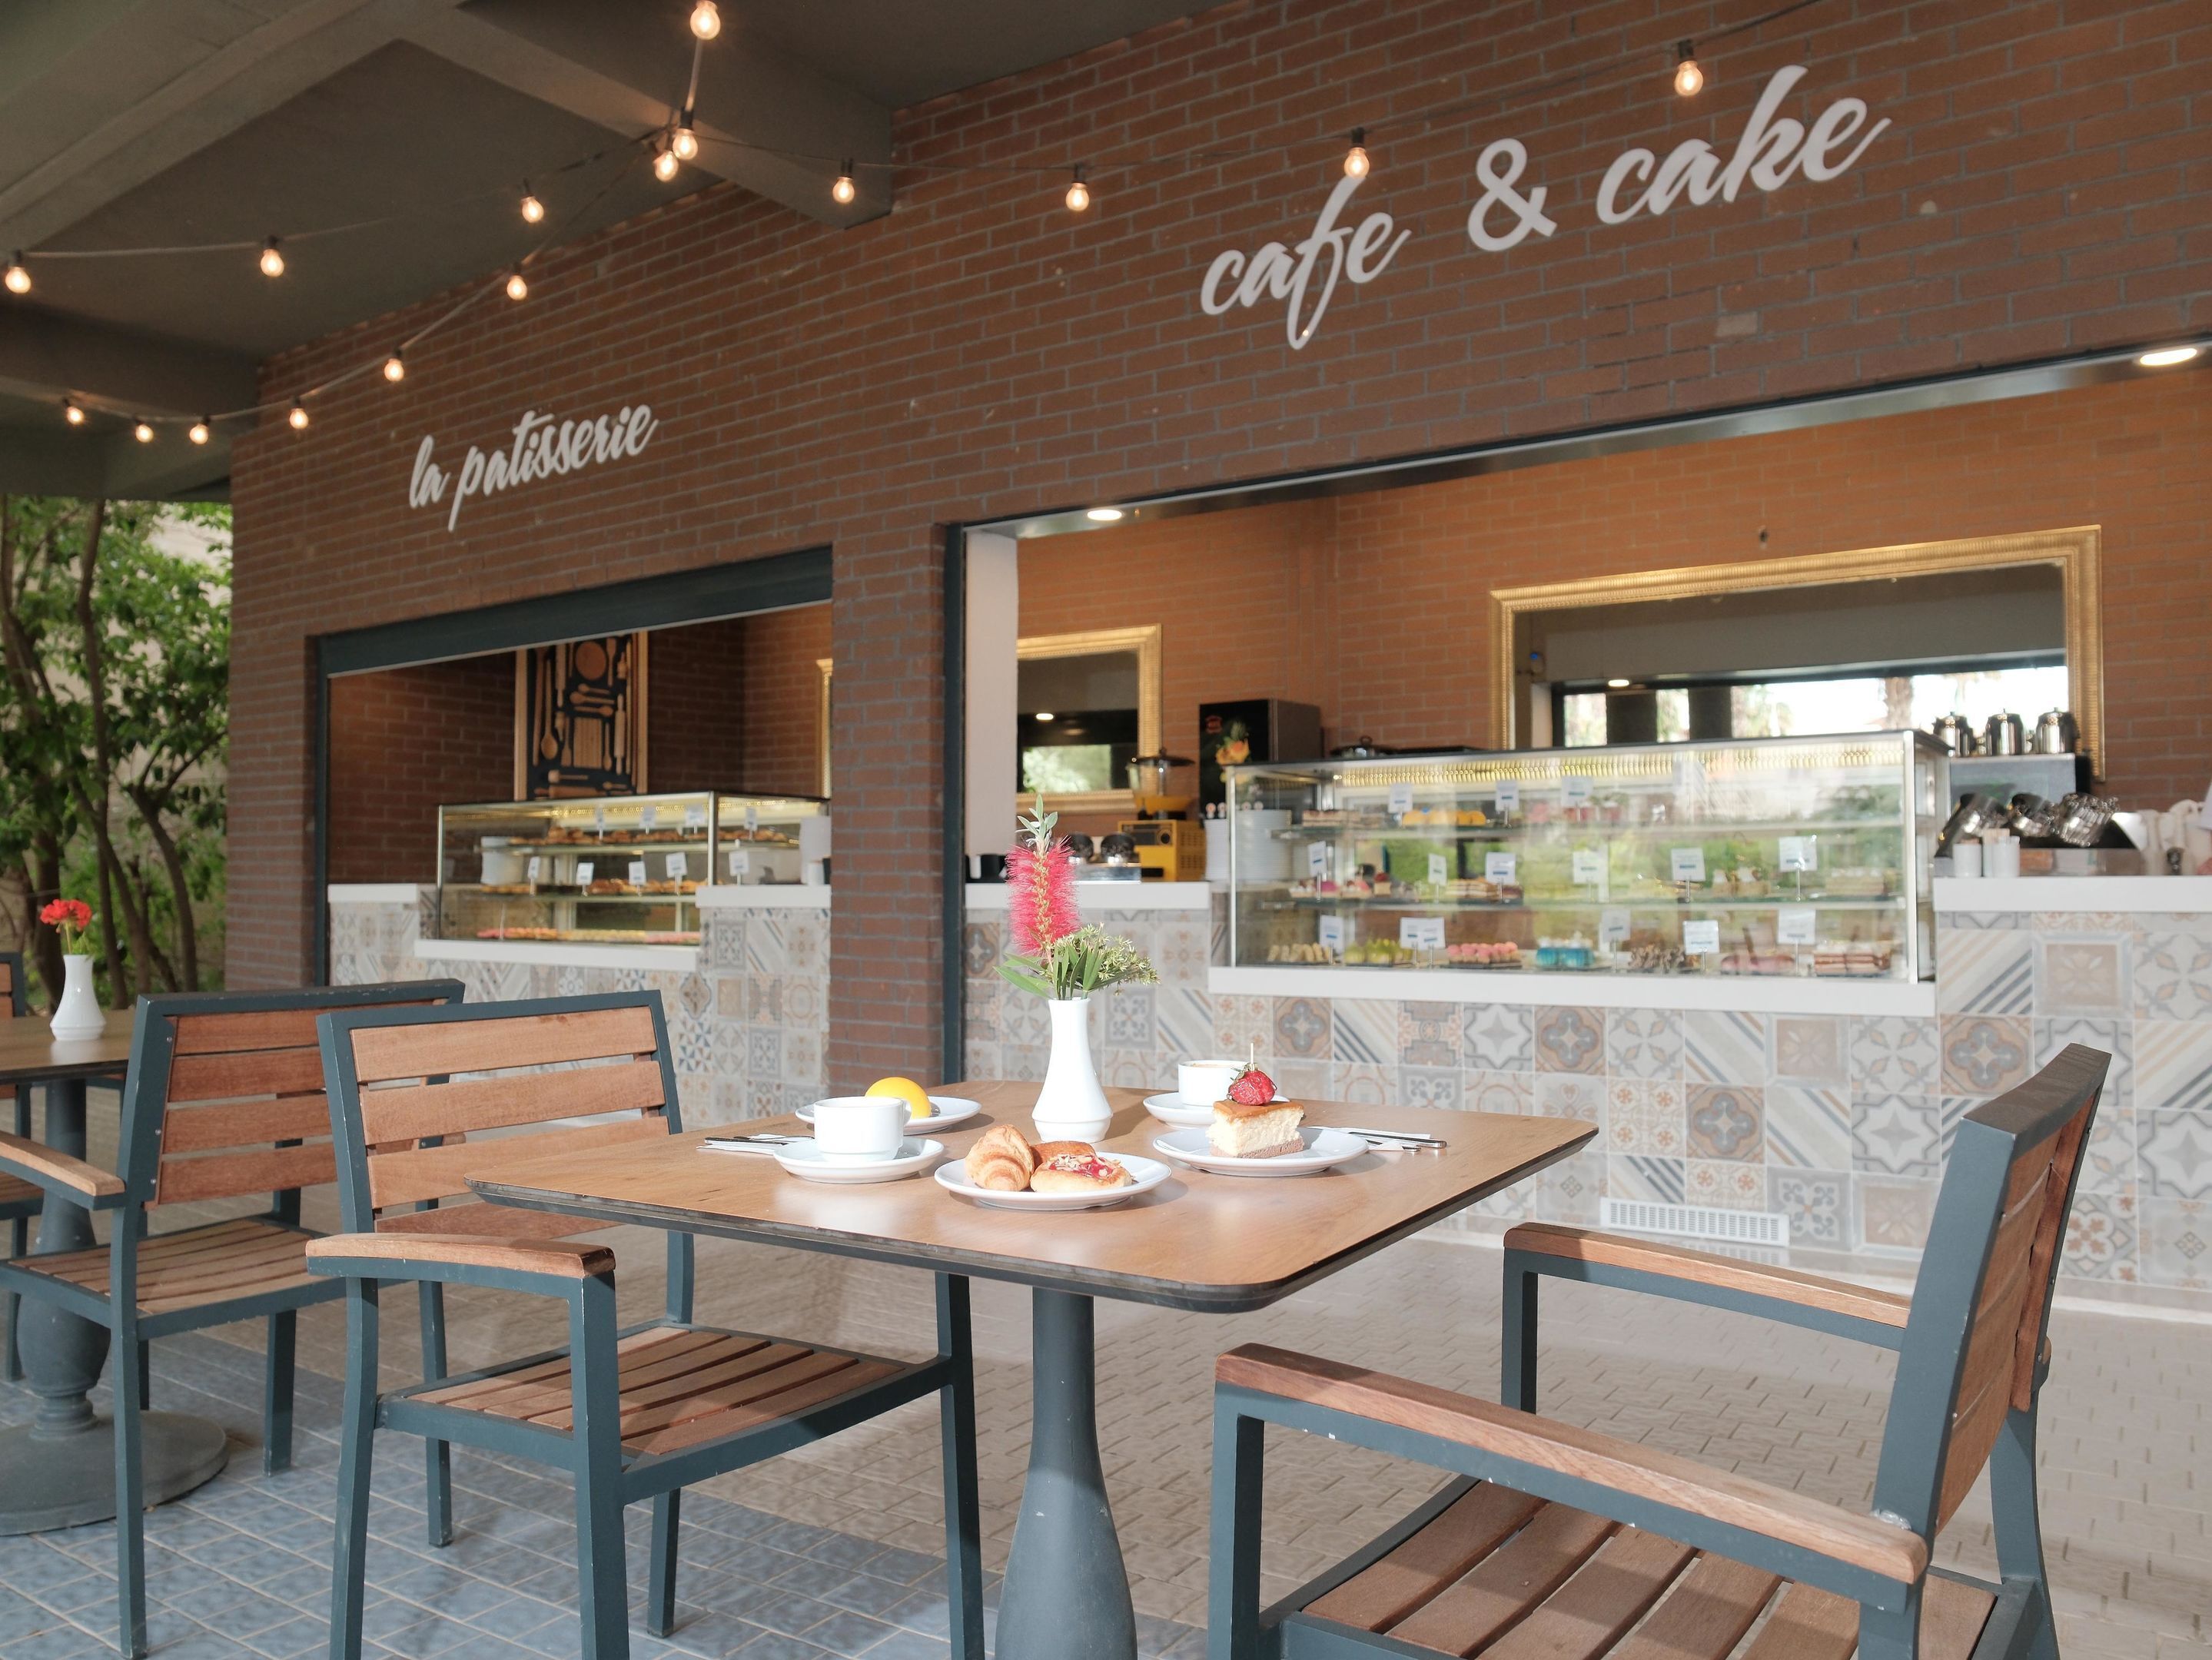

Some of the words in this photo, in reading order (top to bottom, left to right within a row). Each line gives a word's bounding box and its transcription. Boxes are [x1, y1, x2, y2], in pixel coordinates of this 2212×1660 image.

[1201, 174, 1411, 350] cafe
[1468, 138, 1557, 252] &
[1596, 65, 1891, 224] cake
[409, 435, 451, 509] la
[447, 403, 659, 533] patisserie
